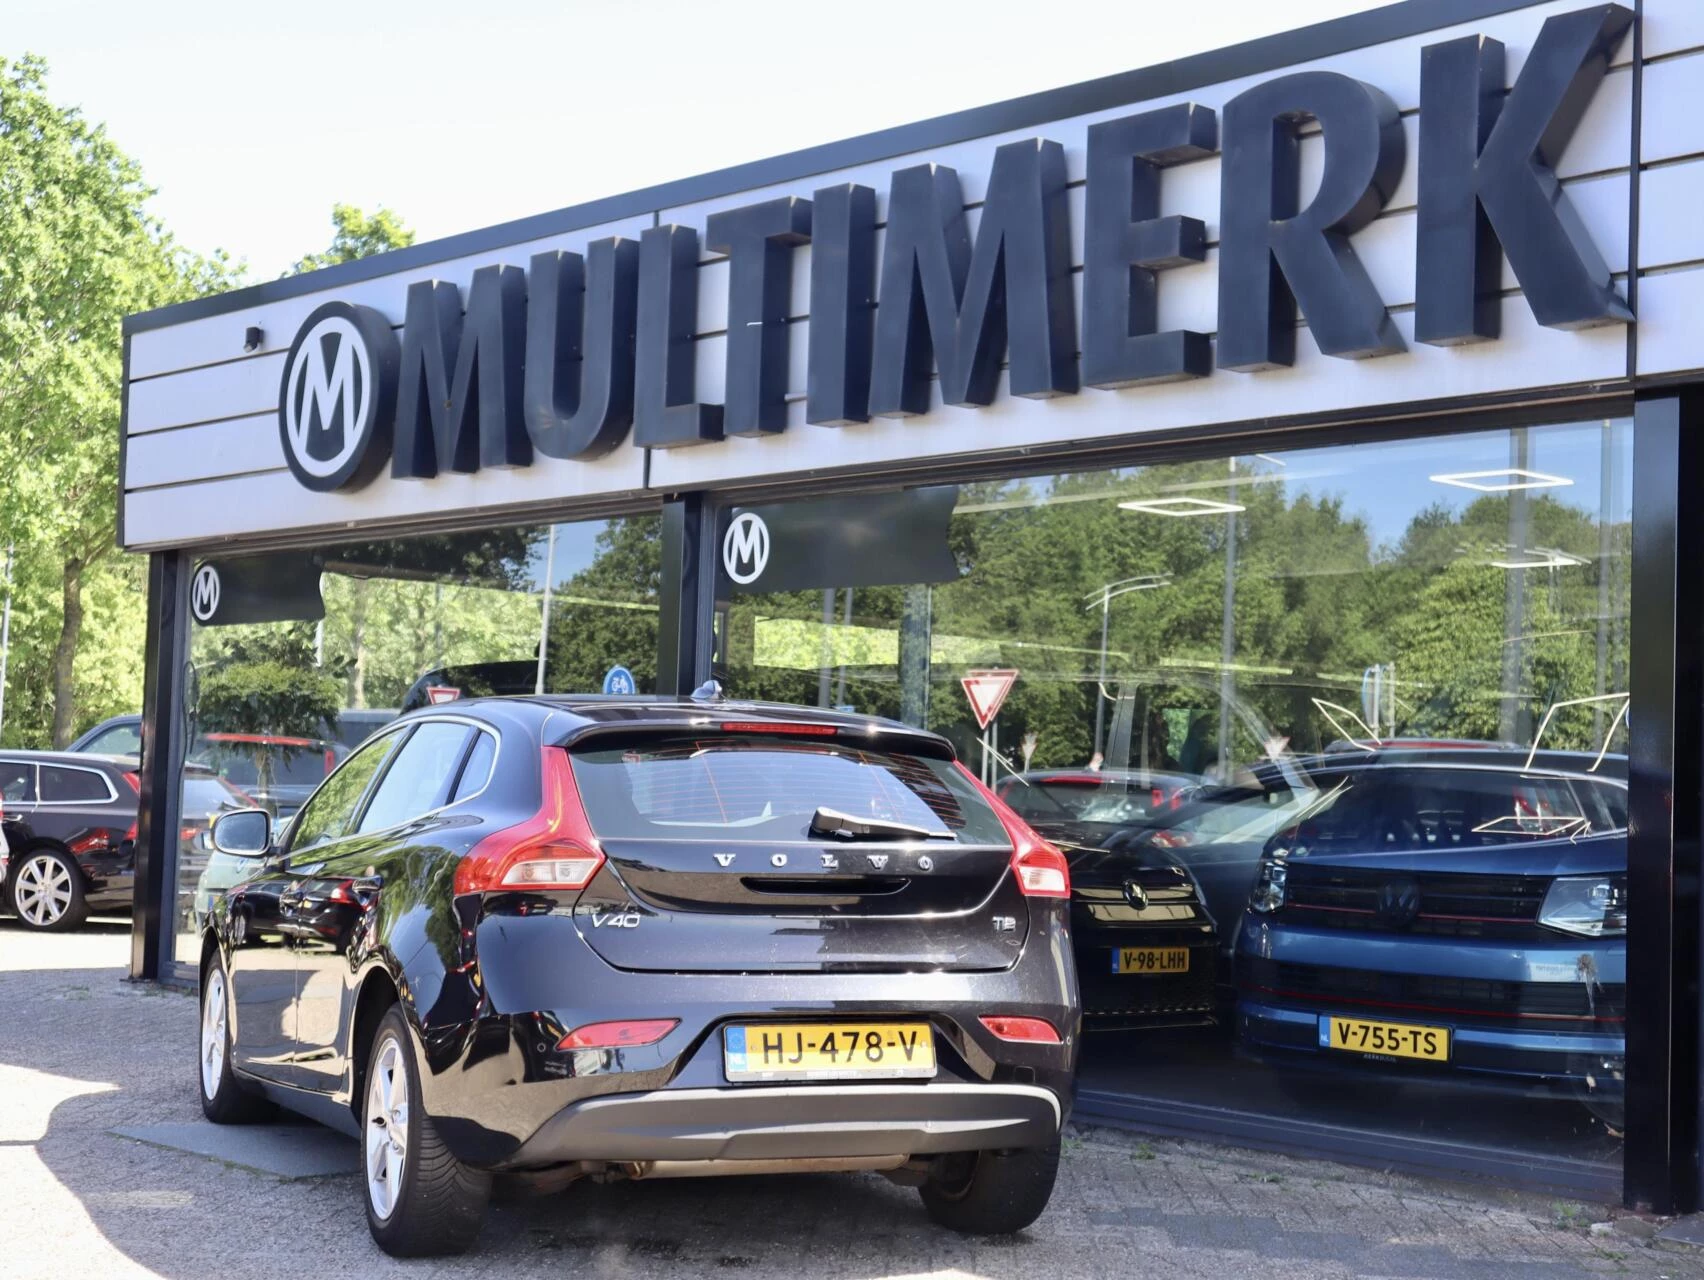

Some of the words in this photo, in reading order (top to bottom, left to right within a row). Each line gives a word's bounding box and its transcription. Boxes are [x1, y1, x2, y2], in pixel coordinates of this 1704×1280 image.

[391, 2, 1635, 480] MULTIMERK
[286, 316, 372, 478] M
[723, 512, 770, 585] M
[192, 566, 220, 621] M
[713, 853, 934, 871] VOLVO
[591, 913, 641, 928] V40
[1123, 951, 1186, 970] V-98-LHH
[762, 1031, 917, 1064] HJ-478-V
[1338, 1022, 1438, 1055] V-755-TS
